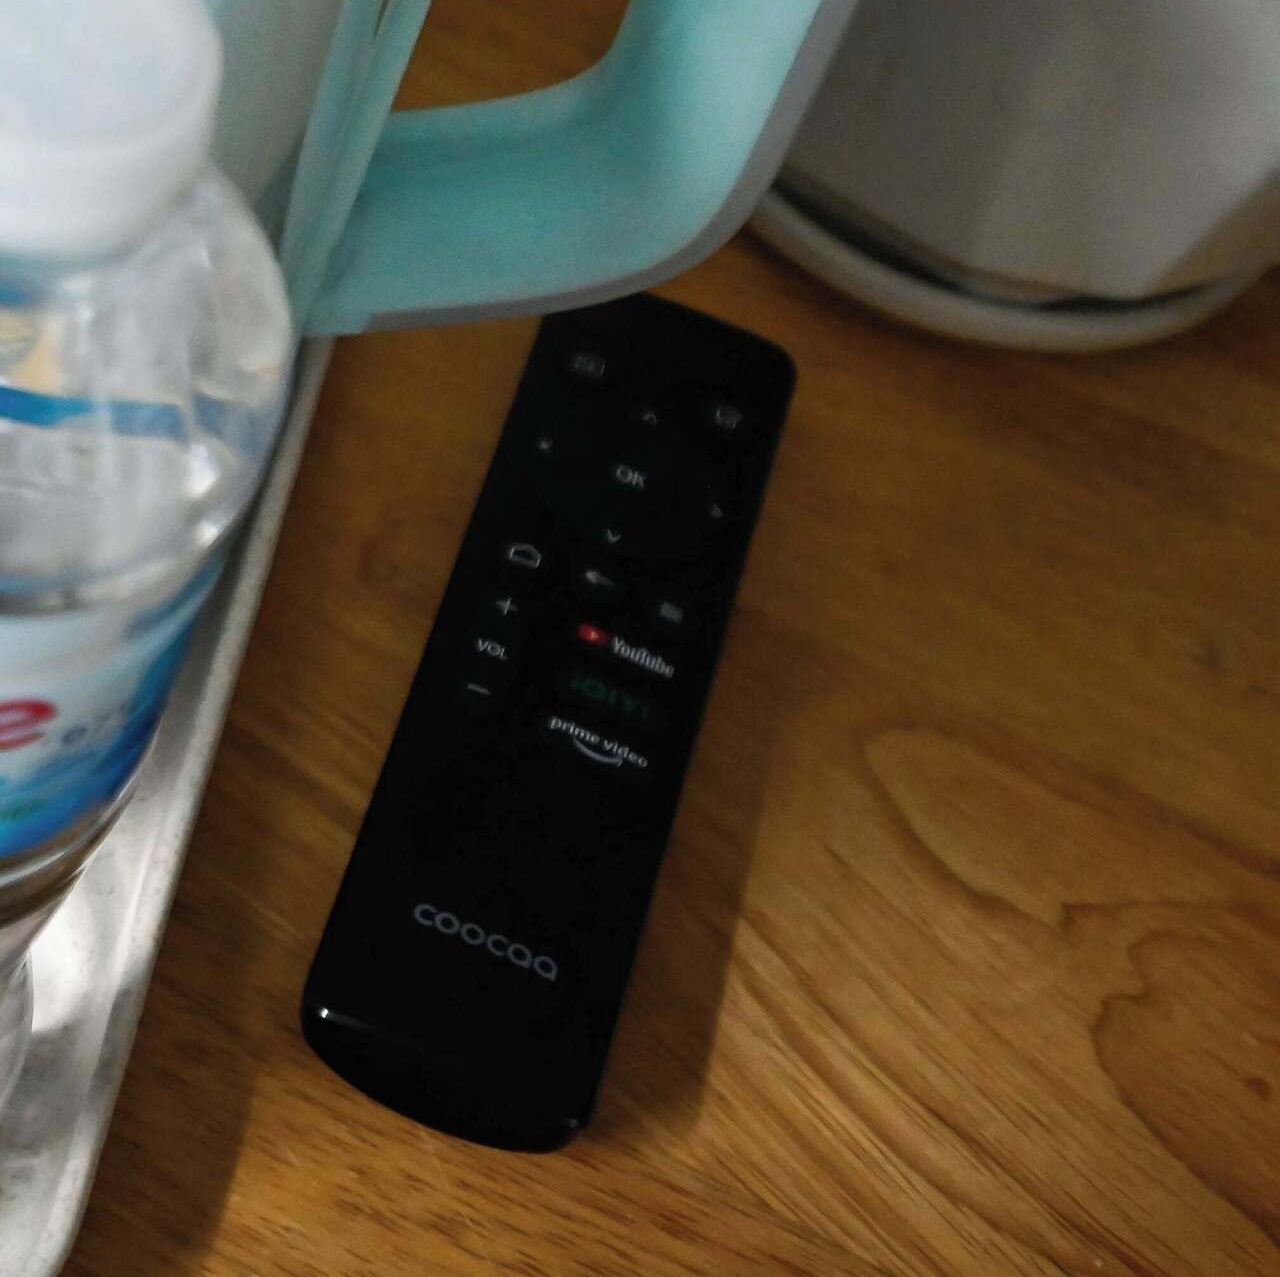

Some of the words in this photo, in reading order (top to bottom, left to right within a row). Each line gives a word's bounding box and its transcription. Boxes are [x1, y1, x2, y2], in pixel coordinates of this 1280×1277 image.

[615, 465, 647, 489] OK
[477, 638, 508, 660] VOL
[611, 634, 676, 679] YouTube
[549, 716, 602, 750] prime
[602, 737, 649, 769] video
[413, 903, 558, 982] coocaa
